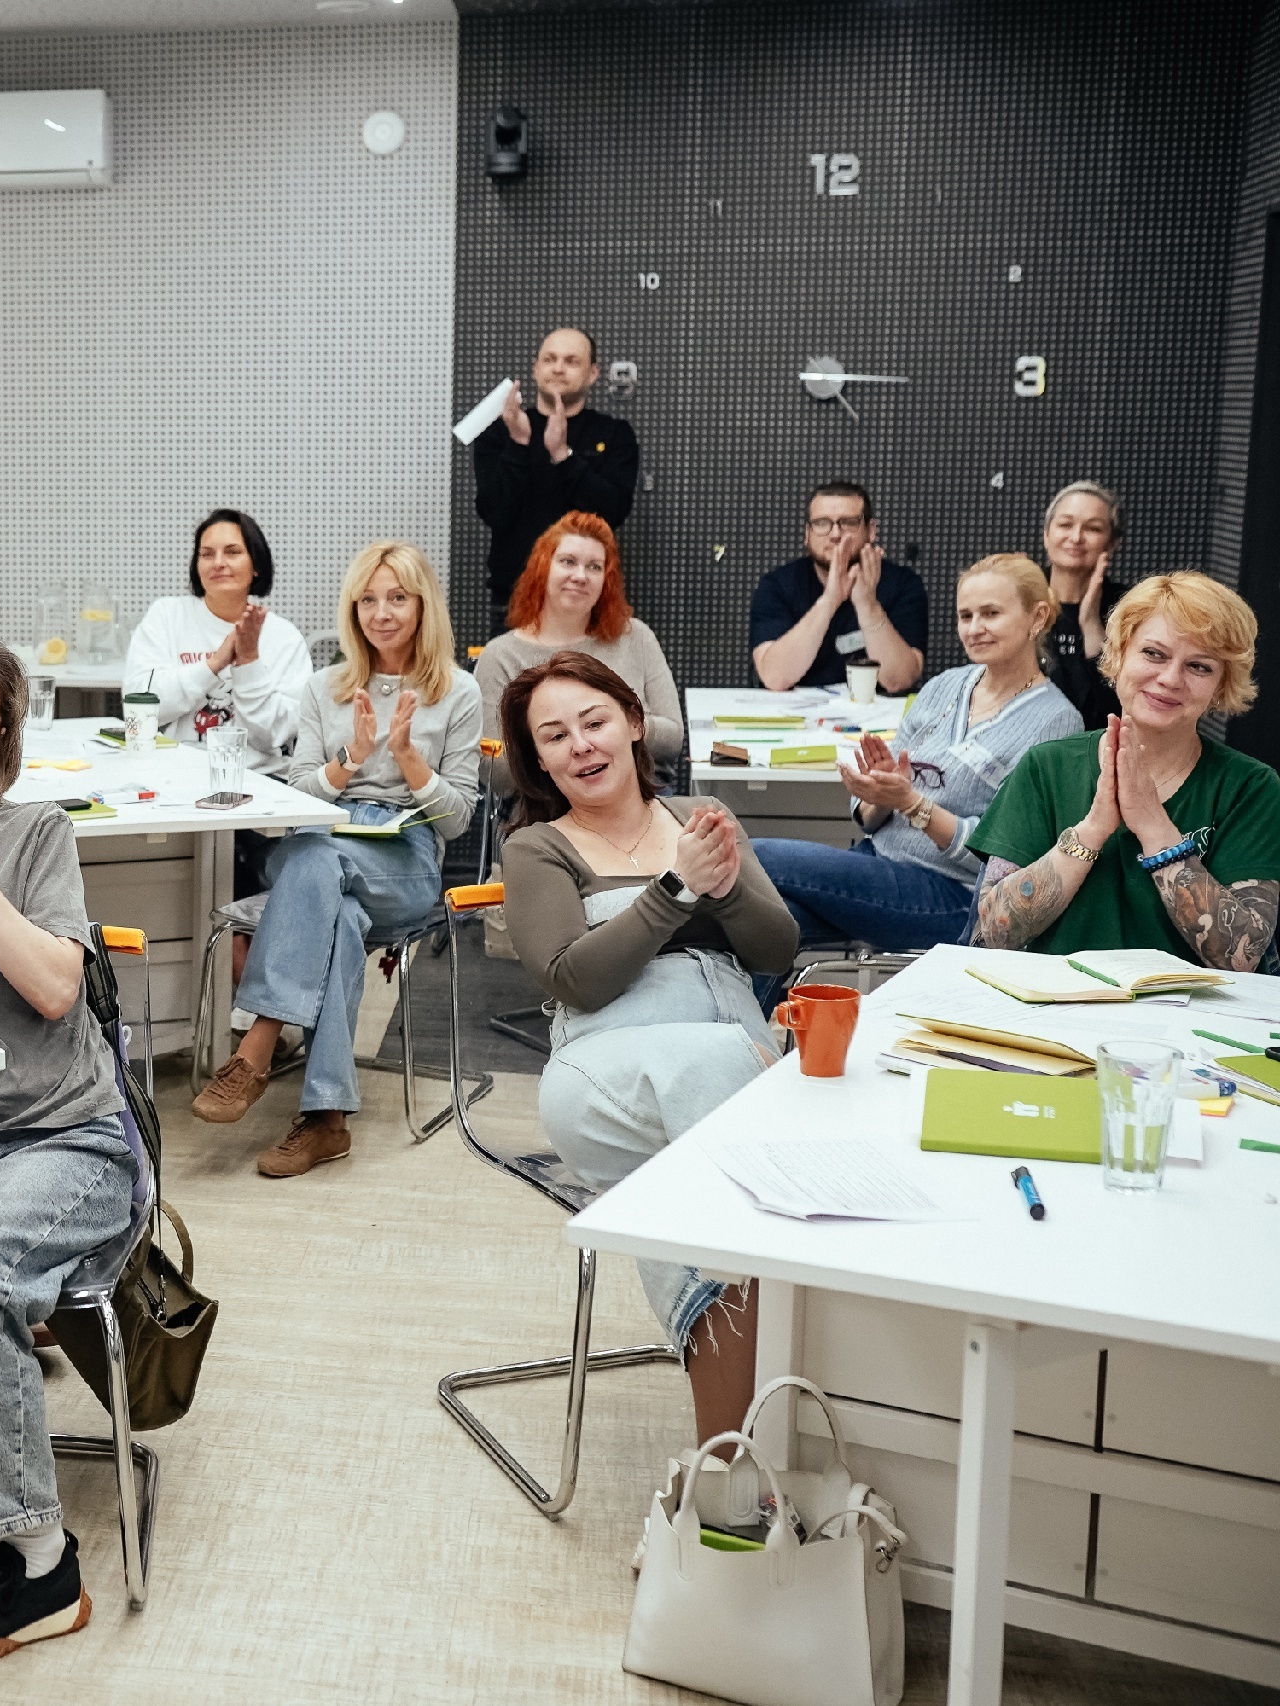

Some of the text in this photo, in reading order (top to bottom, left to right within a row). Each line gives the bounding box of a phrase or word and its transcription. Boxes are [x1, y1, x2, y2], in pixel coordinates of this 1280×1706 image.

[810, 152, 860, 196] 12
[637, 271, 661, 291] 10
[608, 361, 638, 401] 9
[1014, 355, 1046, 397] 3
[990, 470, 1005, 490] 4
[712, 543, 725, 563] 7
